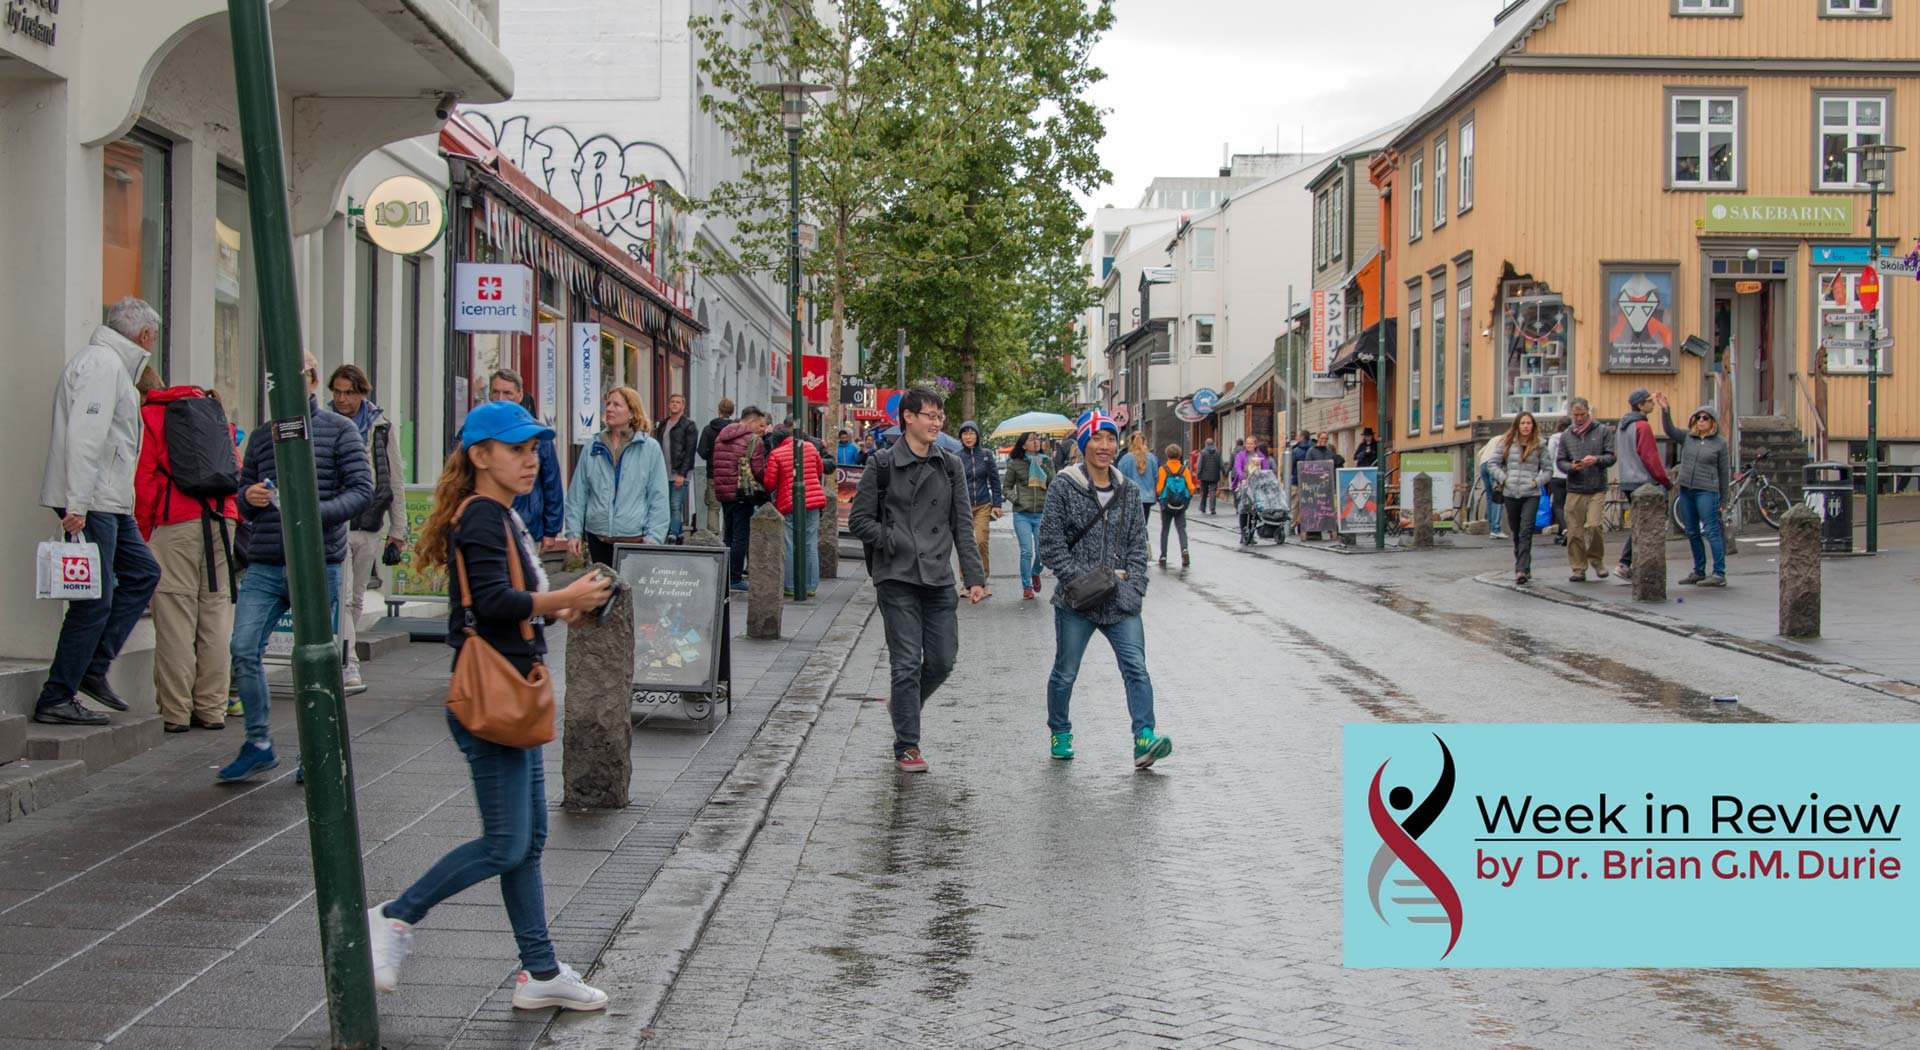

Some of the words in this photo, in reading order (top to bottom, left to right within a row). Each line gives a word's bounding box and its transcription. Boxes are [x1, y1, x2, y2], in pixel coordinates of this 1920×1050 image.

[1730, 205, 1846, 220] SAKEBARINN
[462, 302, 516, 316] icemart
[1619, 354, 1632, 363] the
[1634, 355, 1655, 364] stairs
[652, 567, 677, 576] Come
[679, 568, 688, 576] in
[639, 576, 648, 585] &
[650, 577, 661, 585] be
[663, 578, 700, 588] Inspired
[644, 587, 655, 596] by
[658, 588, 692, 597] Iceland
